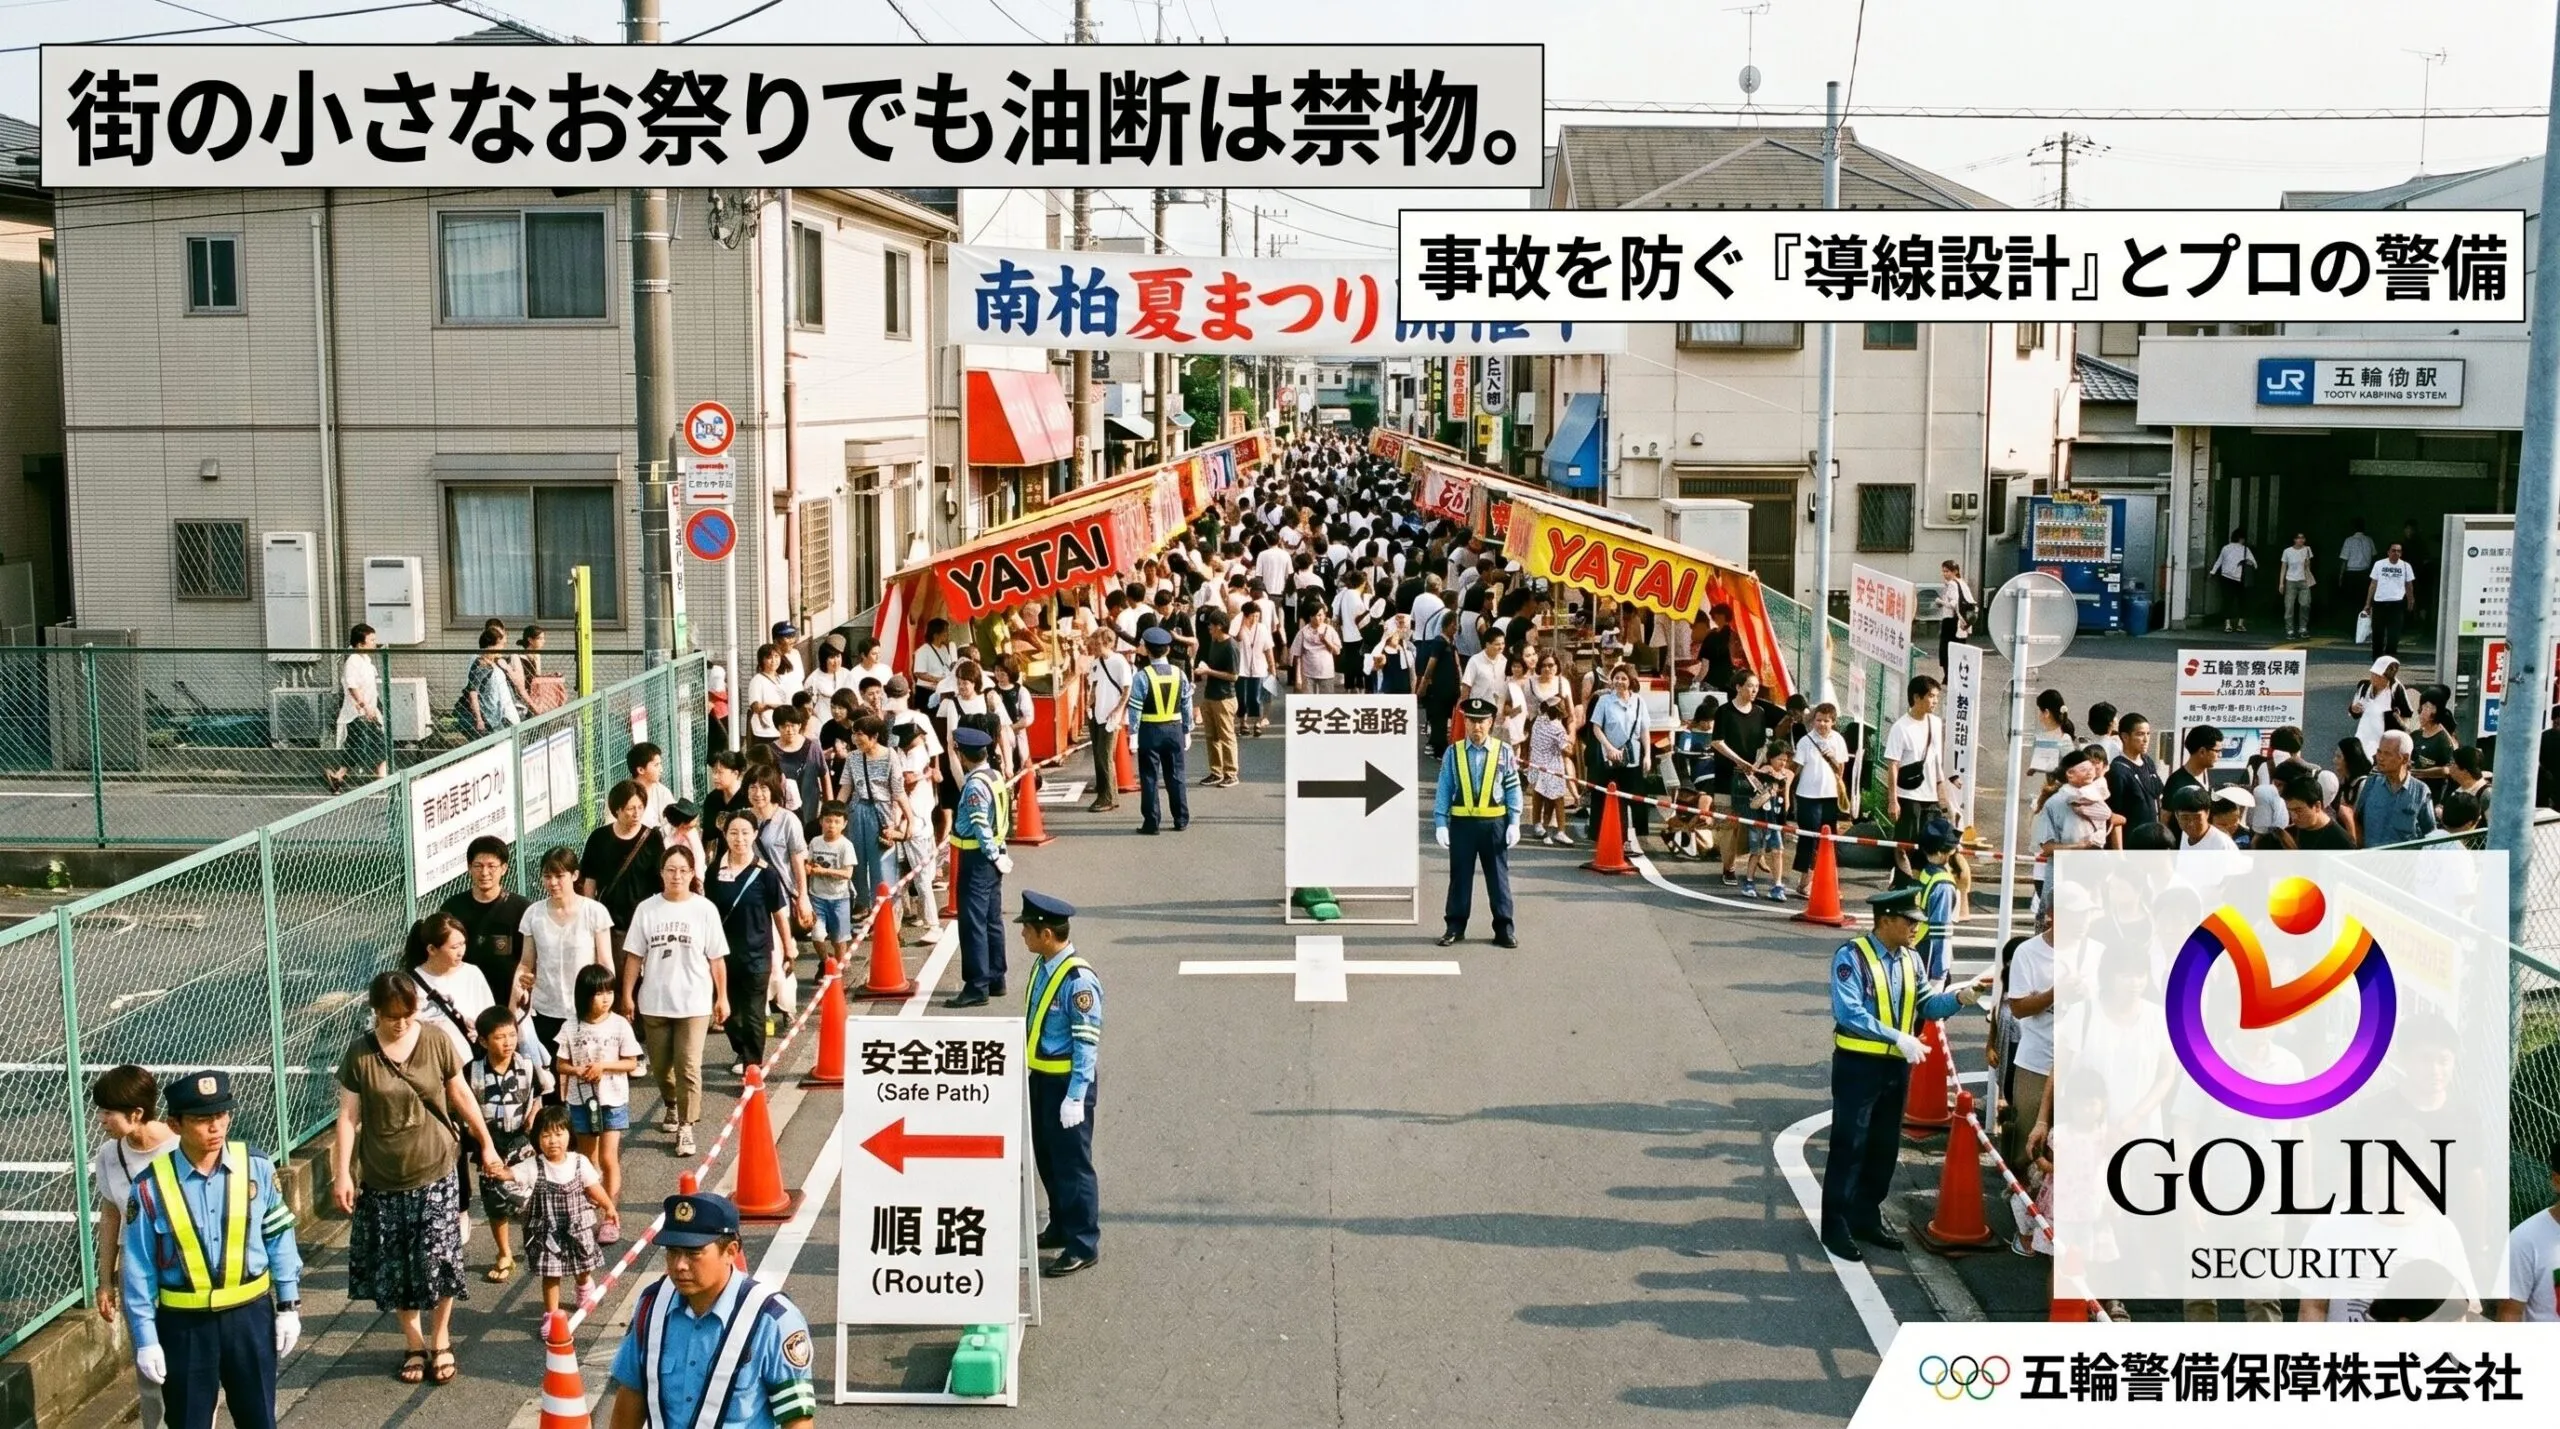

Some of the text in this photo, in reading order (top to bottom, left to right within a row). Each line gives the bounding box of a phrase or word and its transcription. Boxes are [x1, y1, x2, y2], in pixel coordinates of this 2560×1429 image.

[976, 258, 1573, 342] 南柏夏まつり
[2266, 369, 2305, 391] JR
[2406, 391, 2447, 400] SYSTEM
[949, 524, 1110, 608] YATAI
[1547, 528, 1698, 612] YATAI
[1295, 707, 1409, 735] 安全通路
[861, 1039, 1007, 1076] 安全通路
[877, 1082, 990, 1104] (Safe Path)
[870, 1205, 987, 1257] 順路
[872, 1267, 984, 1297] (Route)
